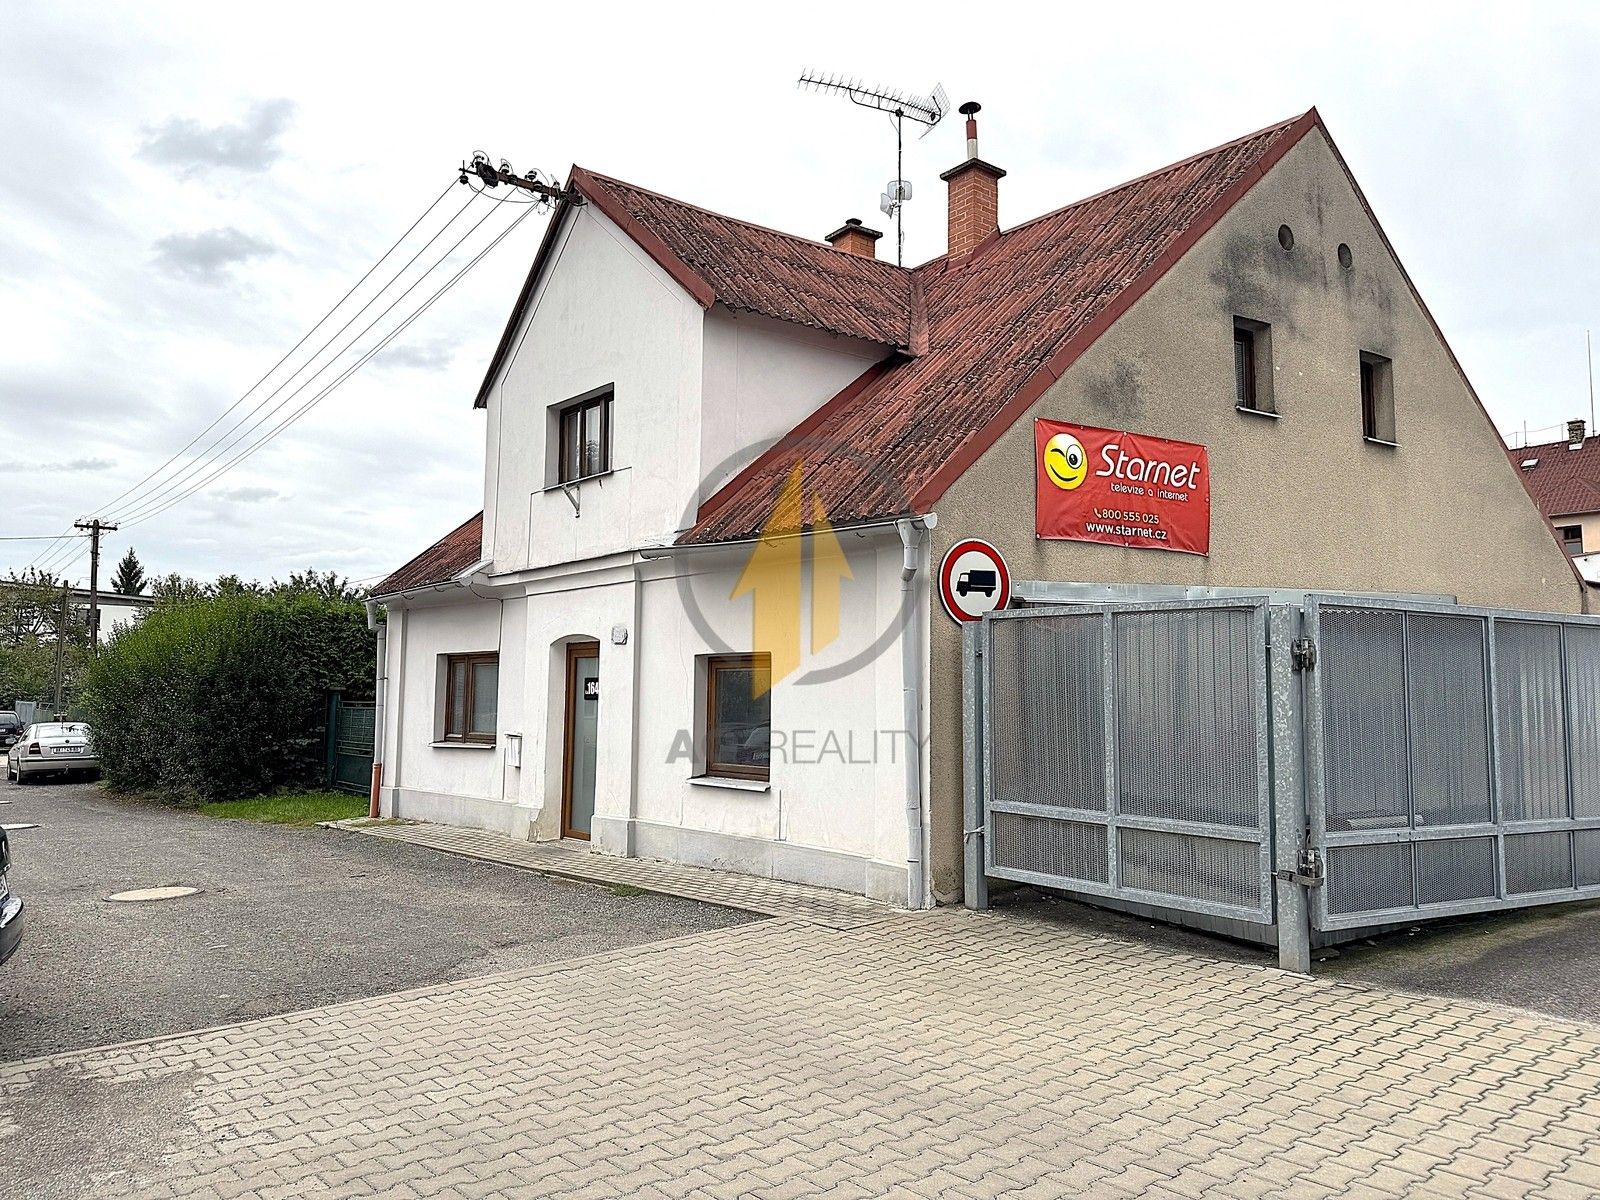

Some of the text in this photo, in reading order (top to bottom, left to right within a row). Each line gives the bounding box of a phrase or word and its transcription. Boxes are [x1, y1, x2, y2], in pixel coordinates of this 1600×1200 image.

[1096, 444, 1200, 489] Starnet
[1110, 482, 1188, 501] televize a internet
[1102, 509, 1160, 524] 800 555 025
[1086, 522, 1167, 540] www.starnet.cz
